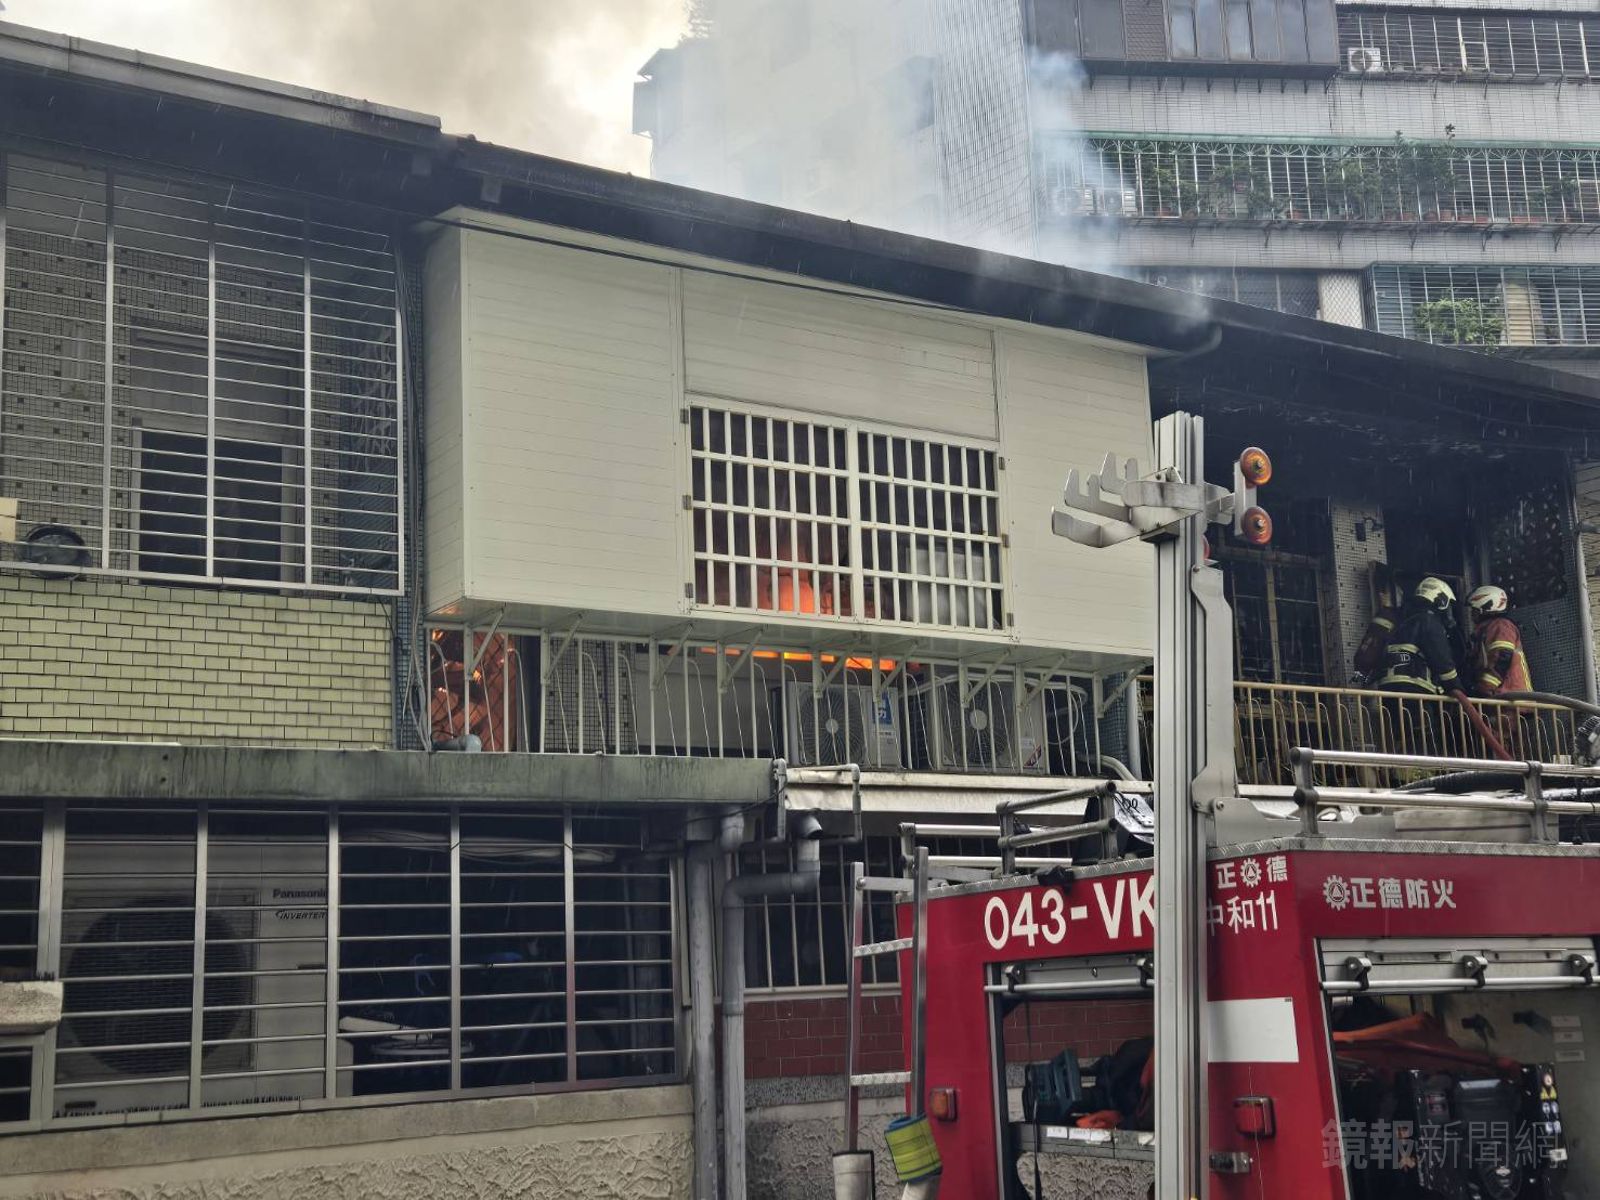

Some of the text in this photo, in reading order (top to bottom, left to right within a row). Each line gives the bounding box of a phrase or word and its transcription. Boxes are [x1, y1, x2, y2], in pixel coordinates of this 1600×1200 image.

[984, 875, 1154, 950] 043-VK
[1350, 877, 1457, 909] 正德防火
